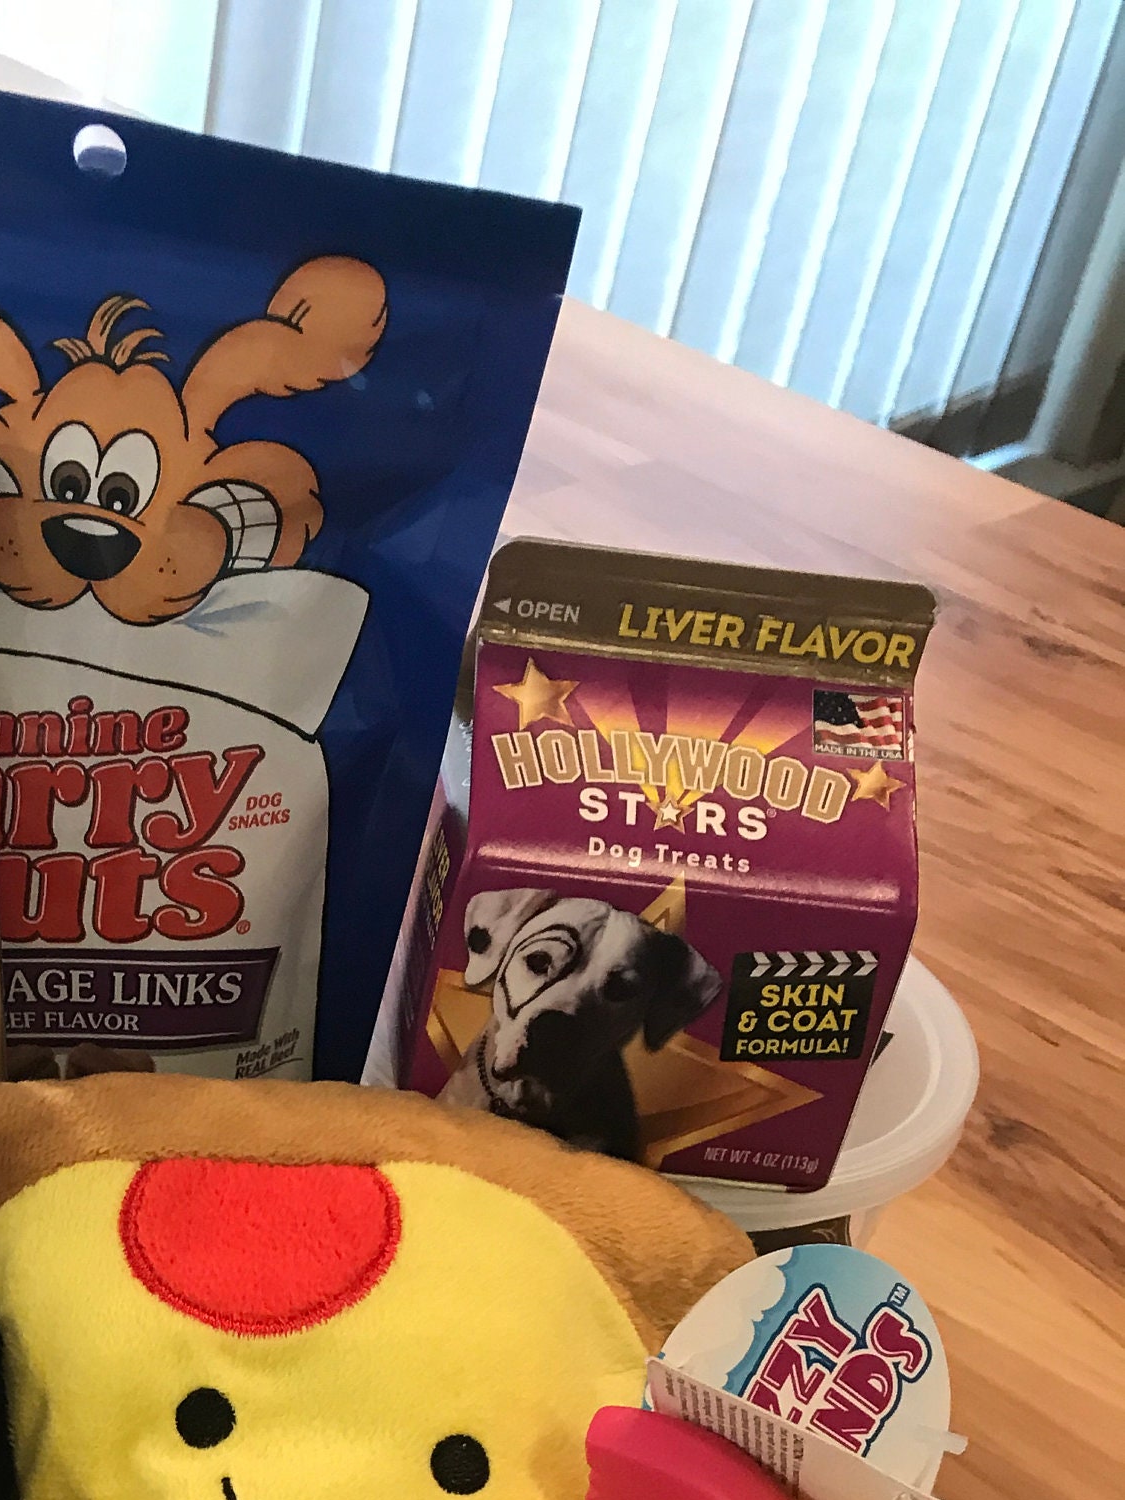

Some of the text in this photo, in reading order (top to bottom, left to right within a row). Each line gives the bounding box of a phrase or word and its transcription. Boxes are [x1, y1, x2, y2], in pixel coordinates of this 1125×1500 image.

[517, 599, 580, 624] OPEN
[618, 603, 917, 669] LIVER FLAVOR
[814, 743, 843, 755] MADE
[846, 746, 857, 756] IN
[881, 749, 903, 760] USA
[490, 729, 852, 824] HOLLYWOOD
[246, 793, 283, 811] DOG
[227, 808, 291, 831] SNACKS
[588, 837, 751, 874] Dog Treats
[112, 970, 244, 1007] LINKS
[759, 983, 845, 1008] SKIN
[45, 1011, 140, 1032] FLAVOR
[737, 1009, 858, 1033] & COAT
[735, 1038, 850, 1055] FORMULA!
[704, 1146, 819, 1174] NET WT 4 OZ (113g)
